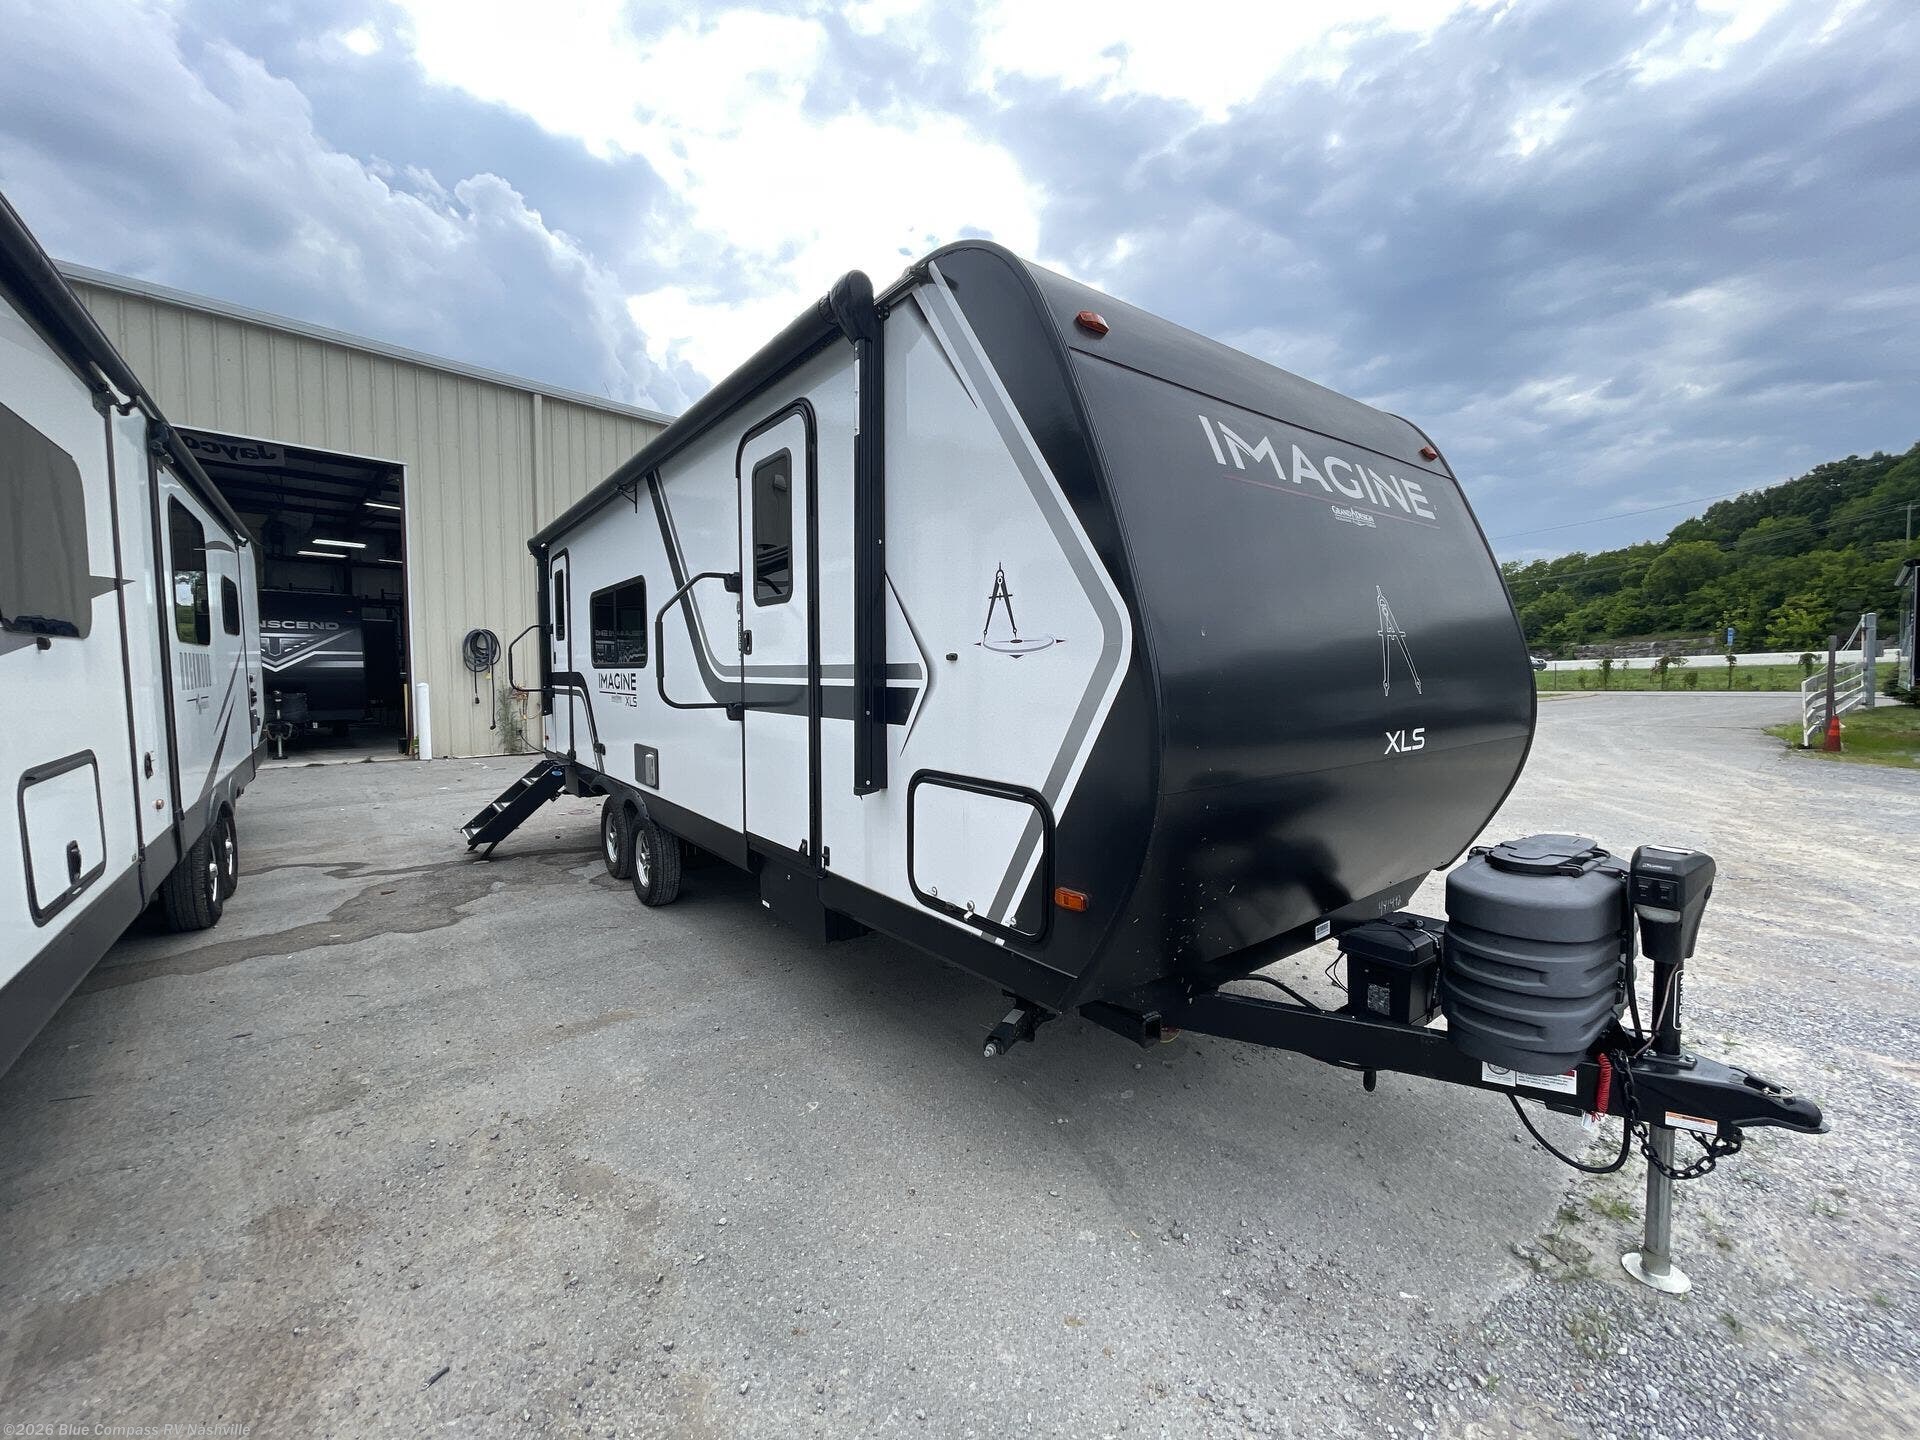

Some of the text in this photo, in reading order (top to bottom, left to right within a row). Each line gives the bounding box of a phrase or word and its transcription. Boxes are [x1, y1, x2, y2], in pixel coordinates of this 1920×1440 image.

[1199, 415, 1436, 520] IMAGINE
[599, 673, 636, 690] IMAGINE
[625, 697, 637, 707] XLS
[1384, 728, 1425, 754] XLS
